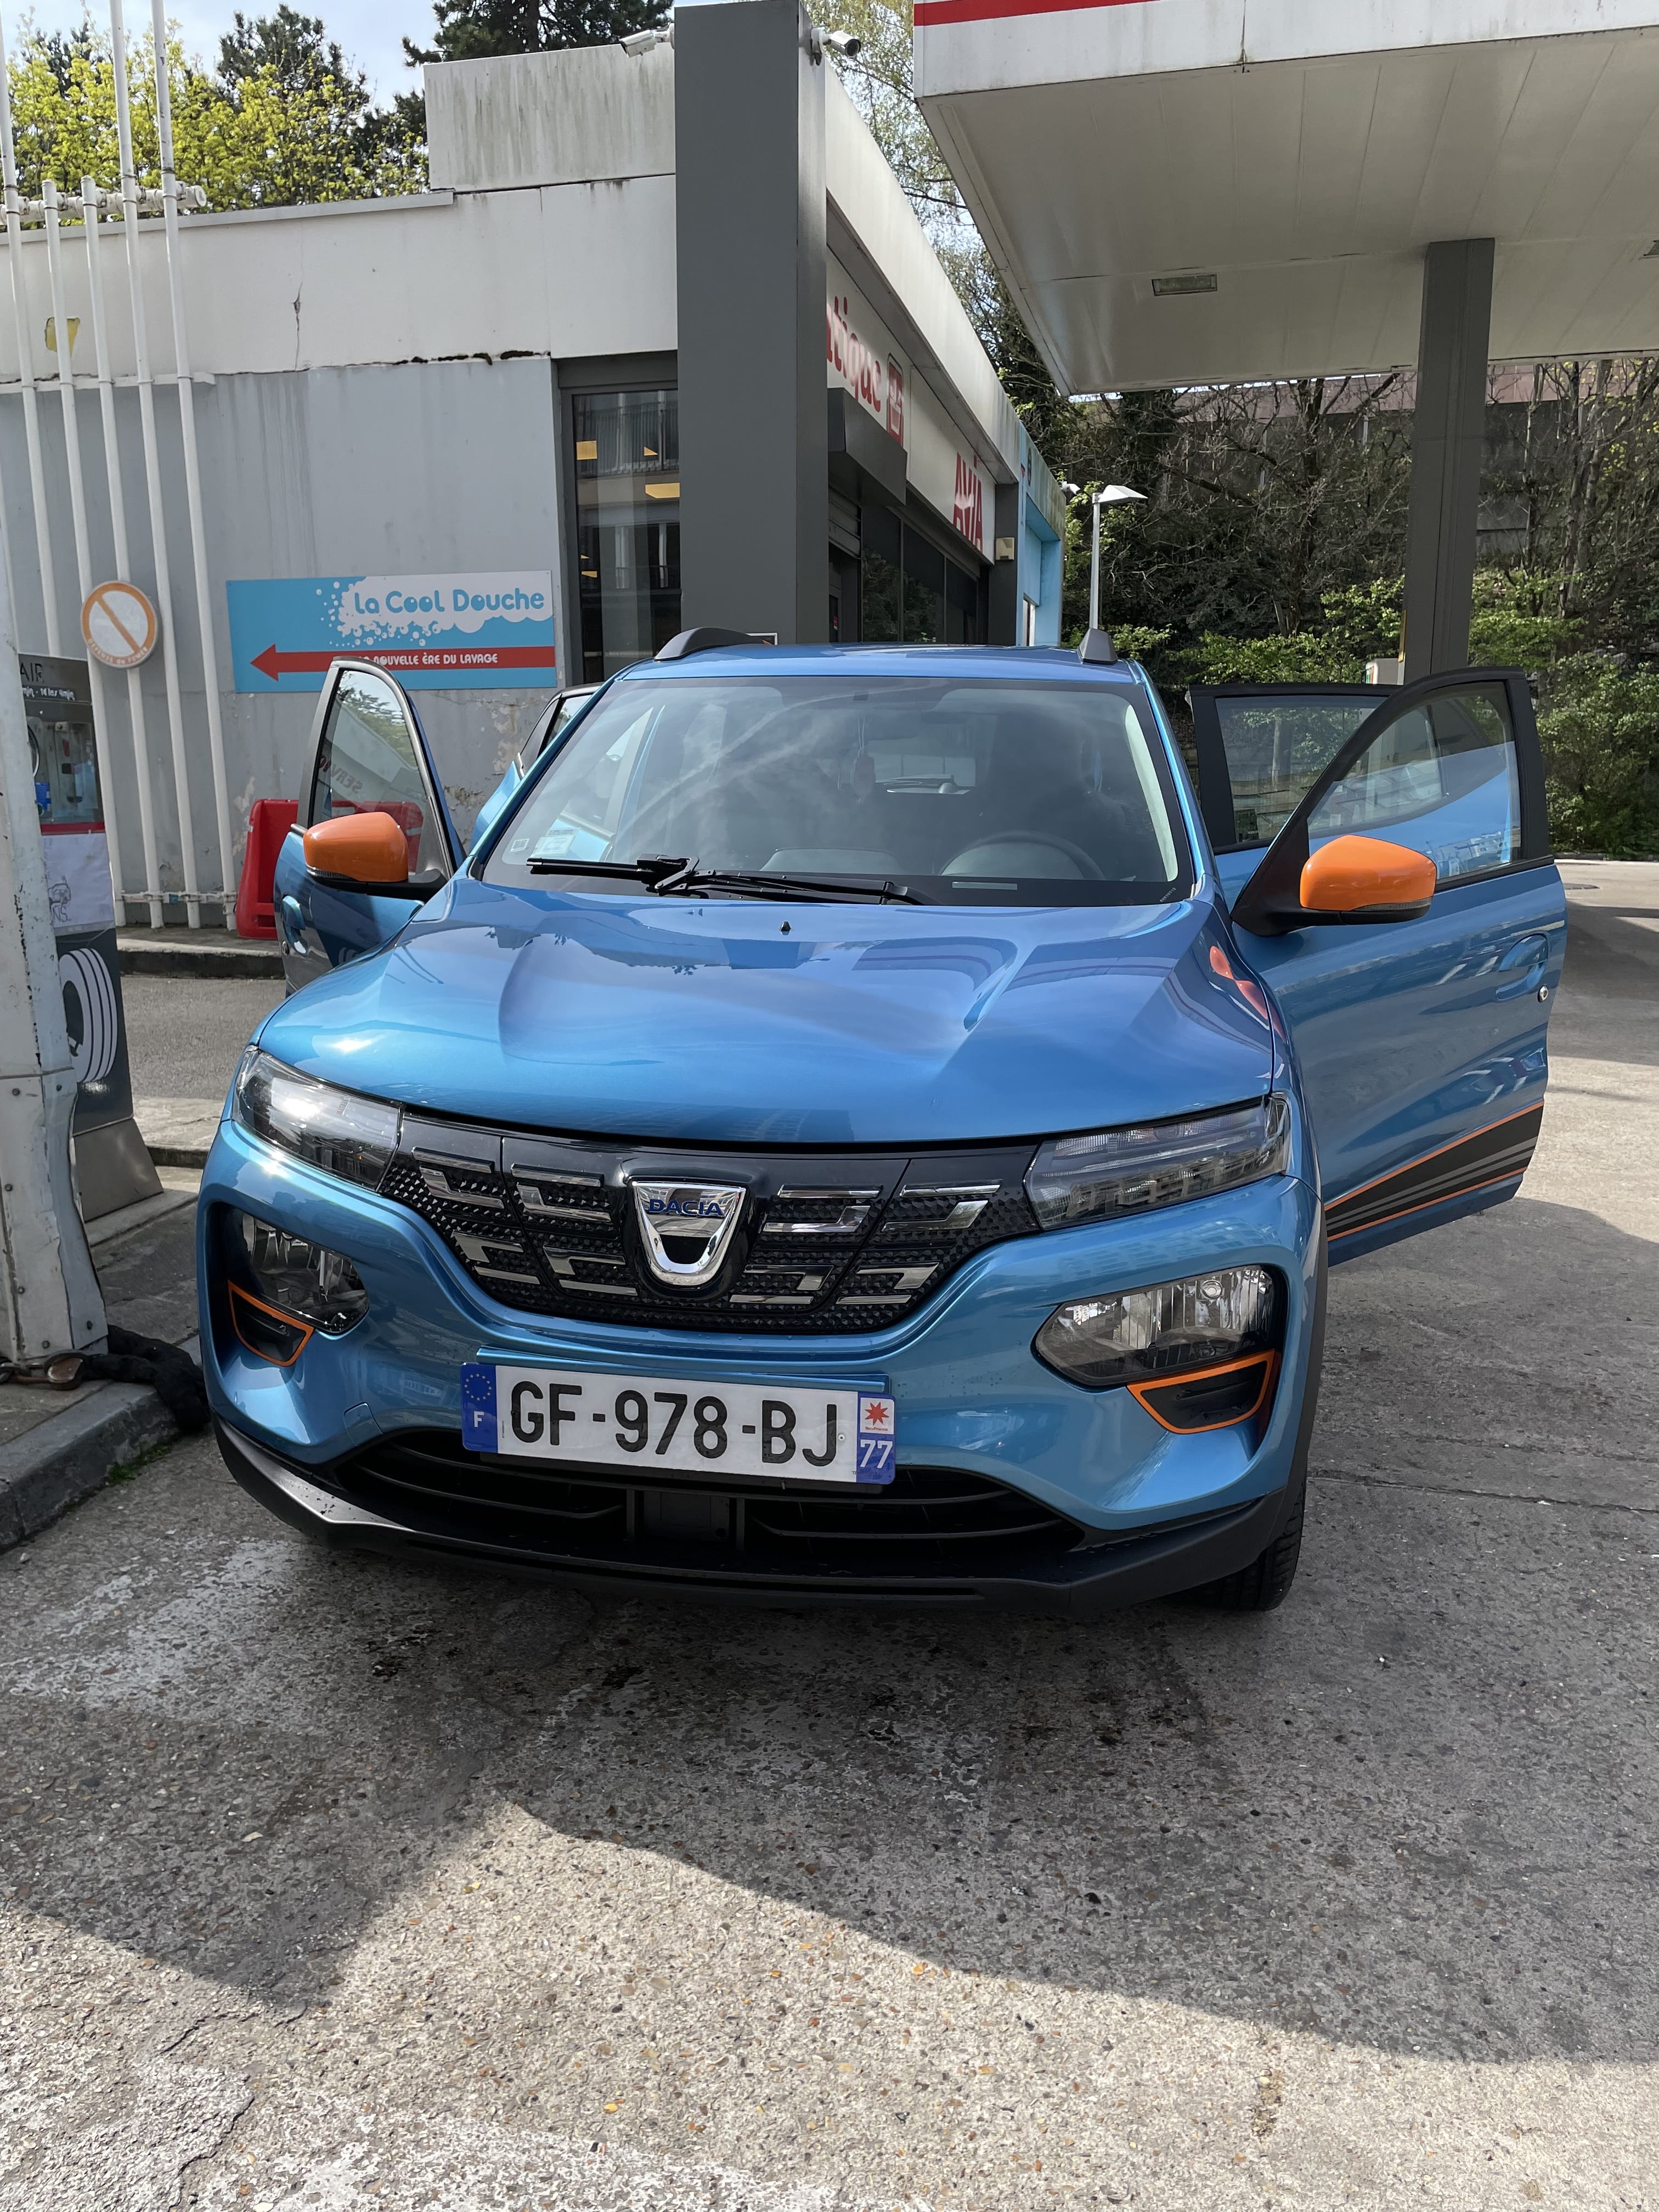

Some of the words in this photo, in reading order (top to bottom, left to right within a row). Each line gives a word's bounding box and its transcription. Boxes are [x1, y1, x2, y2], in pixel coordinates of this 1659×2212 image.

[953, 452, 983, 554] AVIA
[385, 590, 445, 613] Cool
[453, 588, 544, 612] Douche
[443, 654, 457, 664] DU
[460, 653, 498, 664] LAVAGE
[649, 1199, 724, 1216] DACIA
[473, 1410, 485, 1428] F
[511, 1380, 837, 1467] GF-978-BJ
[860, 1438, 893, 1469] 77
